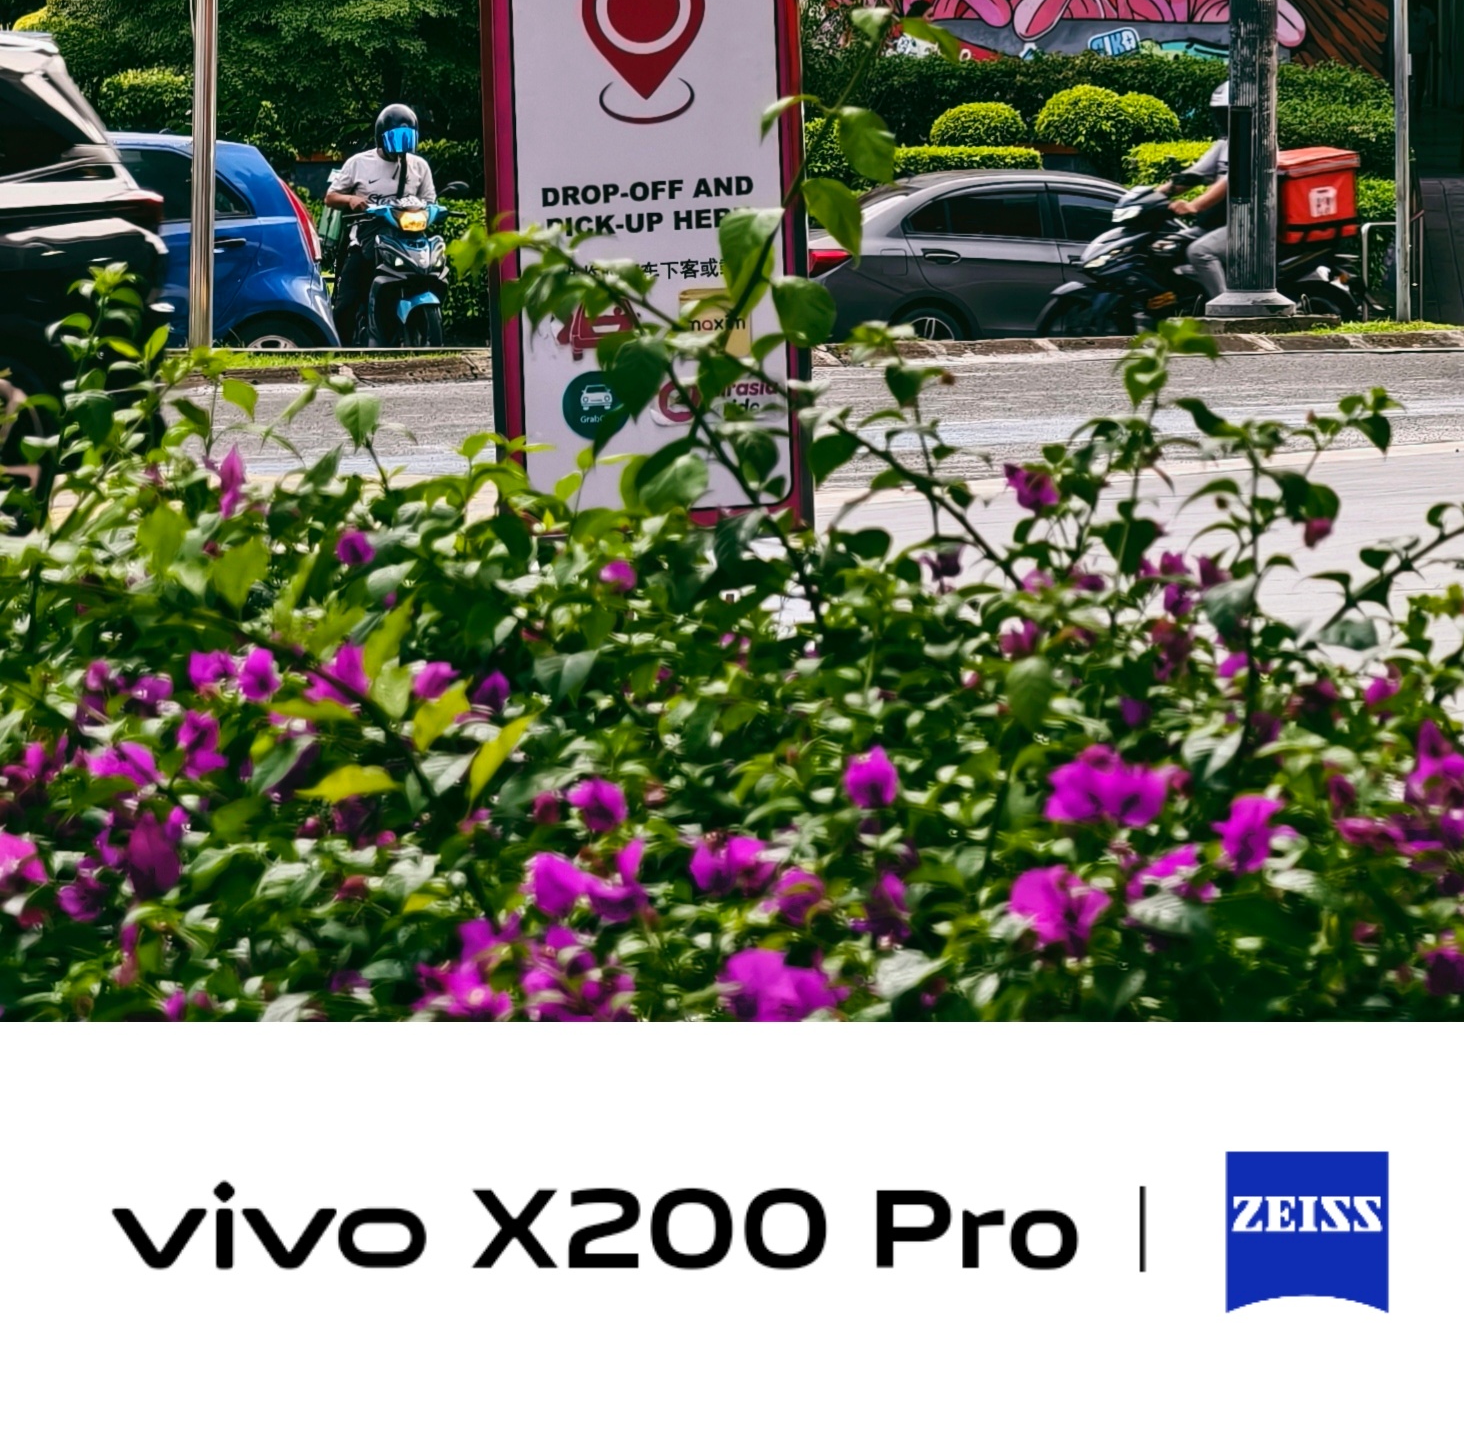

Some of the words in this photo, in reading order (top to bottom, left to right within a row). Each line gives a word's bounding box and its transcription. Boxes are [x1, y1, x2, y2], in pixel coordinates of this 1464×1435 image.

[542, 179, 684, 207] DROP-OFF
[693, 175, 754, 198] AND
[674, 207, 751, 230] HER
[687, 316, 746, 331] maxm
